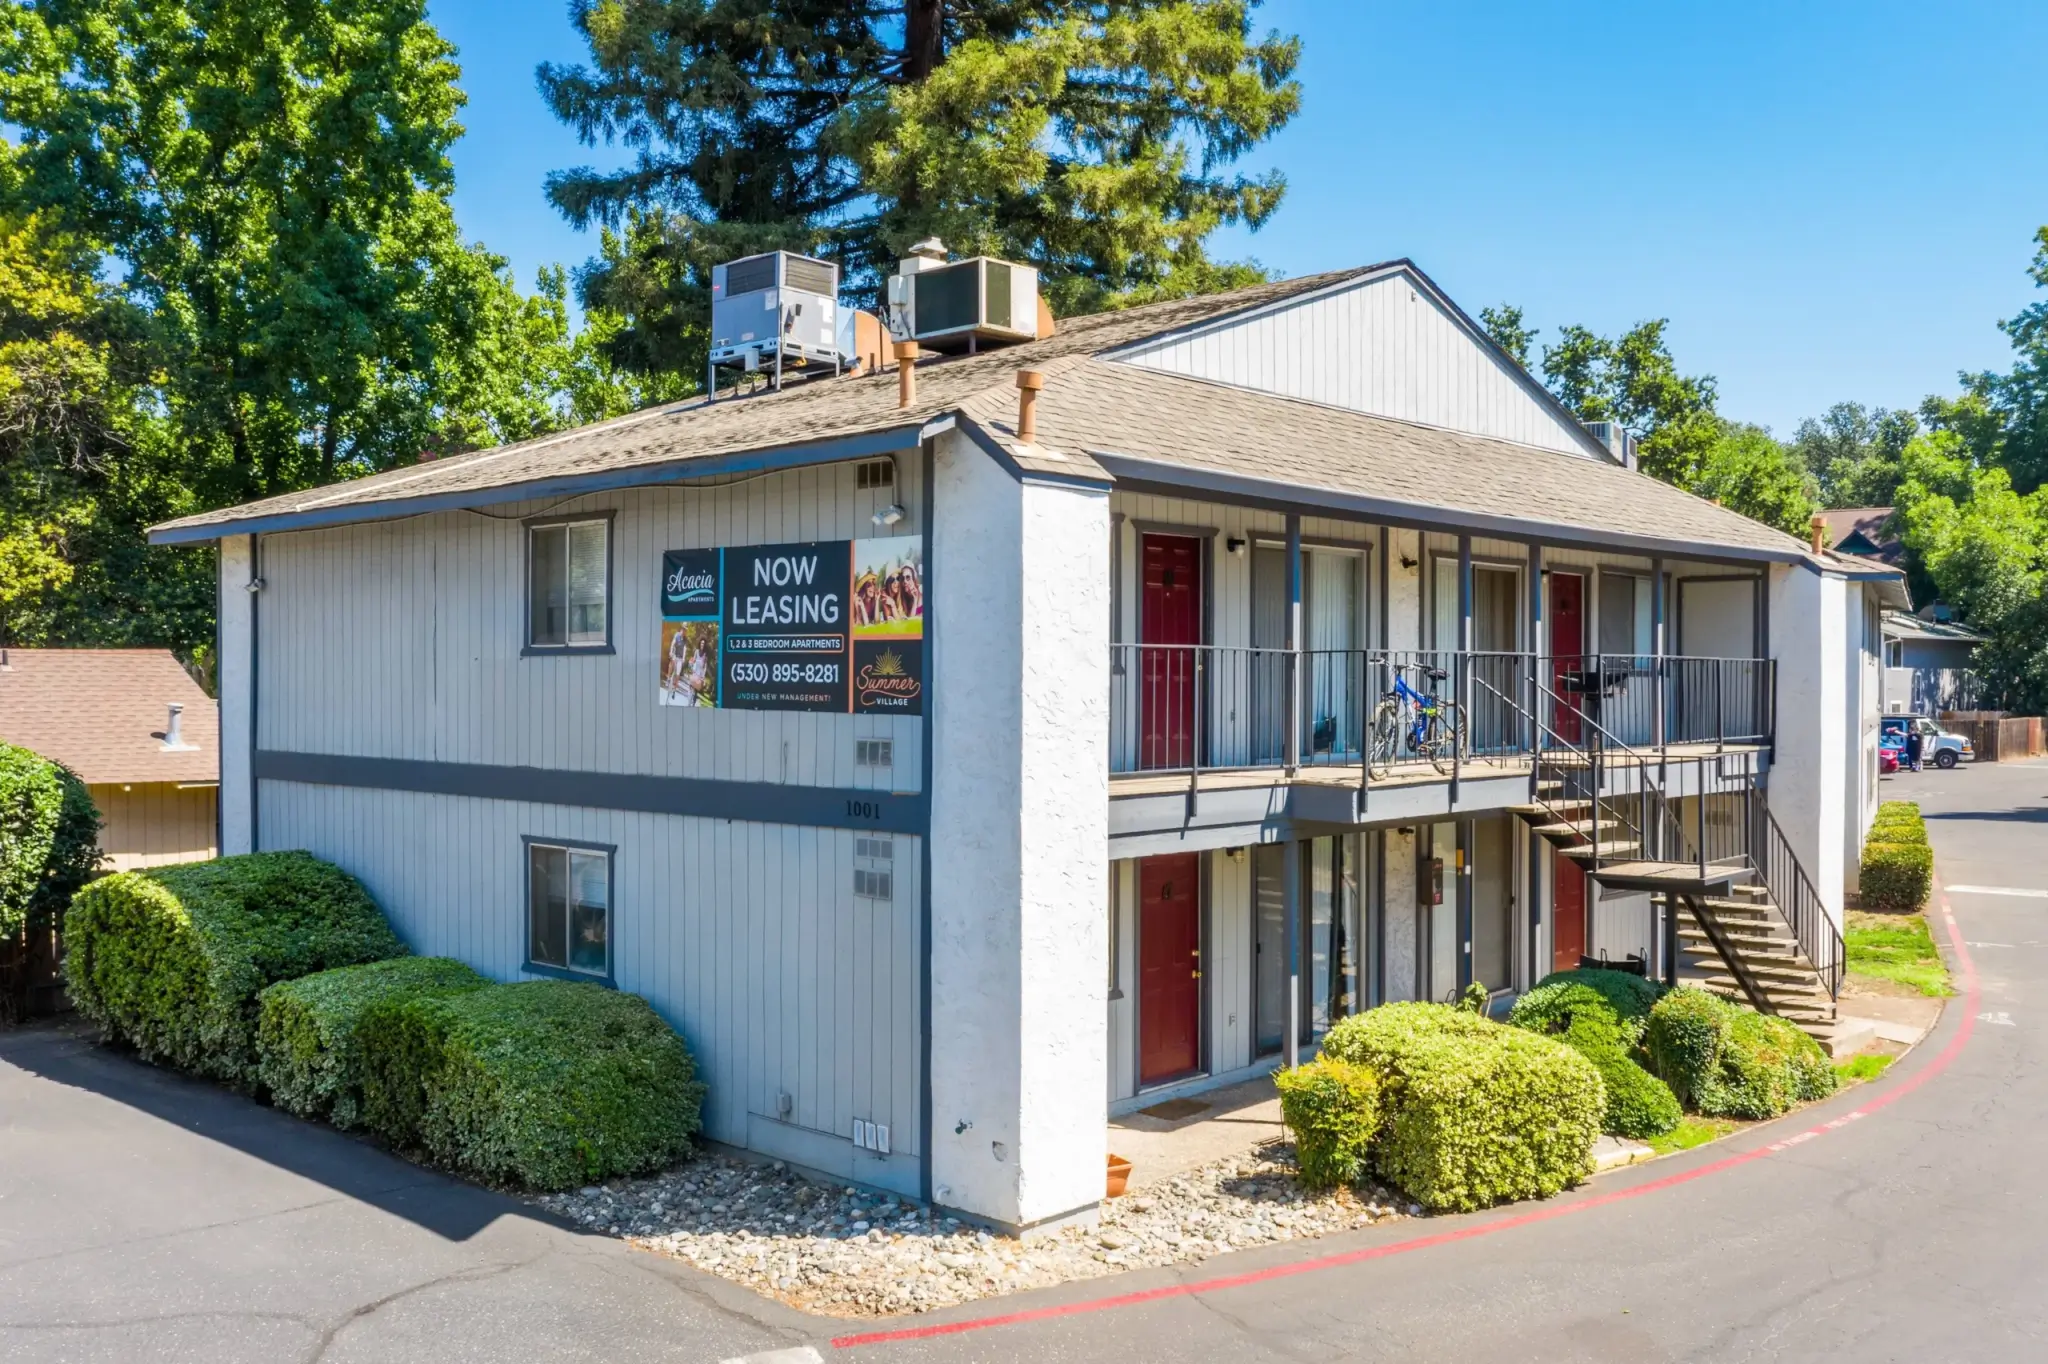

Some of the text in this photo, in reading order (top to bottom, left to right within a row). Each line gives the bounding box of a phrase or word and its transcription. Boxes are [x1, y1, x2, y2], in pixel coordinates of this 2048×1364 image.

[667, 566, 715, 592] Acacia
[754, 556, 818, 587] NOW
[732, 593, 839, 624] LEASING
[730, 639, 841, 650] 1, 2 & 3 BEDROOM APARTMENTS
[731, 662, 839, 684] (530) 895-8281
[856, 664, 920, 694] Summer
[737, 692, 760, 700] UNDER
[779, 693, 831, 702] MANAGEMENT!
[876, 697, 908, 706] VILLAGE
[846, 800, 880, 820] 1001
